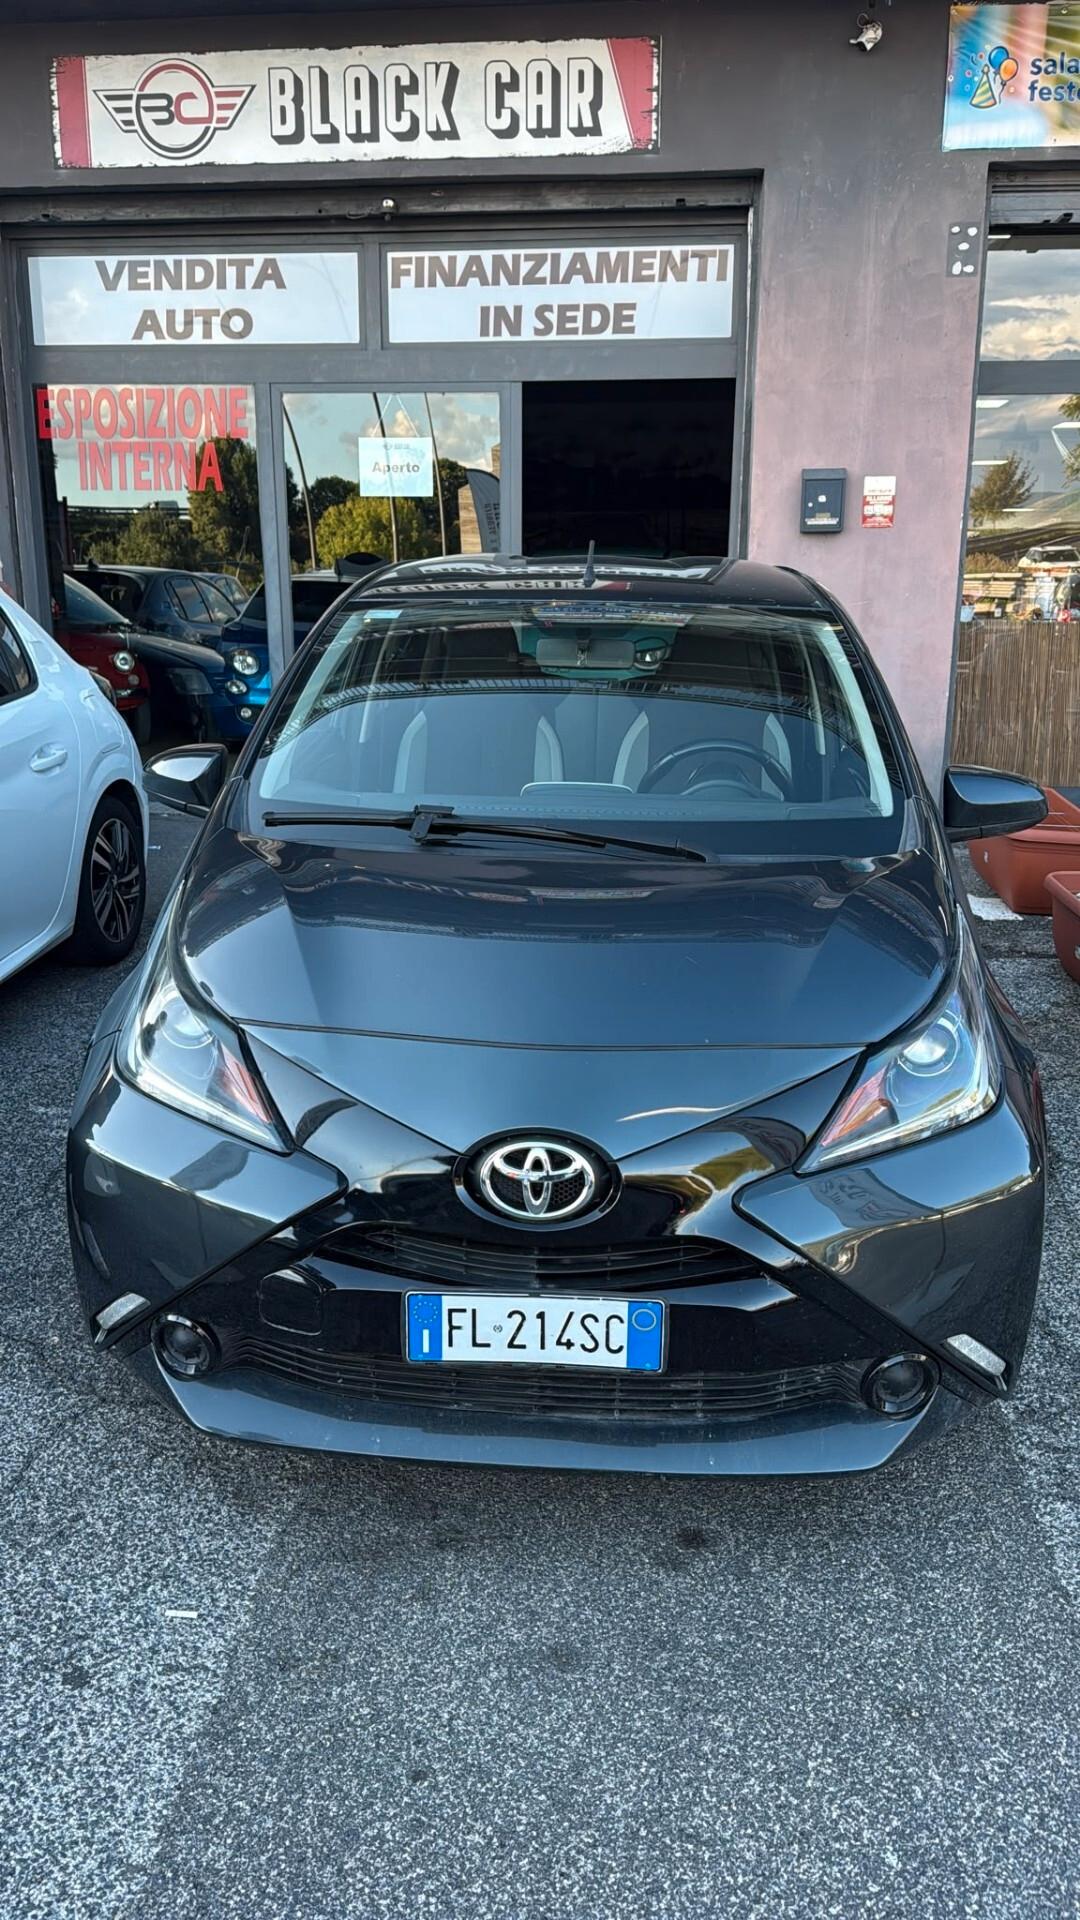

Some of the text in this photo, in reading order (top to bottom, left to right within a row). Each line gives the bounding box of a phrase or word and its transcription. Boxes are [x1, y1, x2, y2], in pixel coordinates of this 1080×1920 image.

[1029, 51, 1080, 76] sala
[268, 56, 603, 145] BLACK CAR
[95, 257, 287, 291] VENDITA
[390, 249, 730, 289] FINANZIAMENTI
[131, 307, 254, 341] AUTO
[479, 302, 637, 337] IN SEDE
[36, 387, 248, 440] ESPOSIZIONE
[78, 441, 224, 492] INTERNA
[372, 462, 421, 475] Aperto
[447, 1308, 625, 1355] FL 214SC
